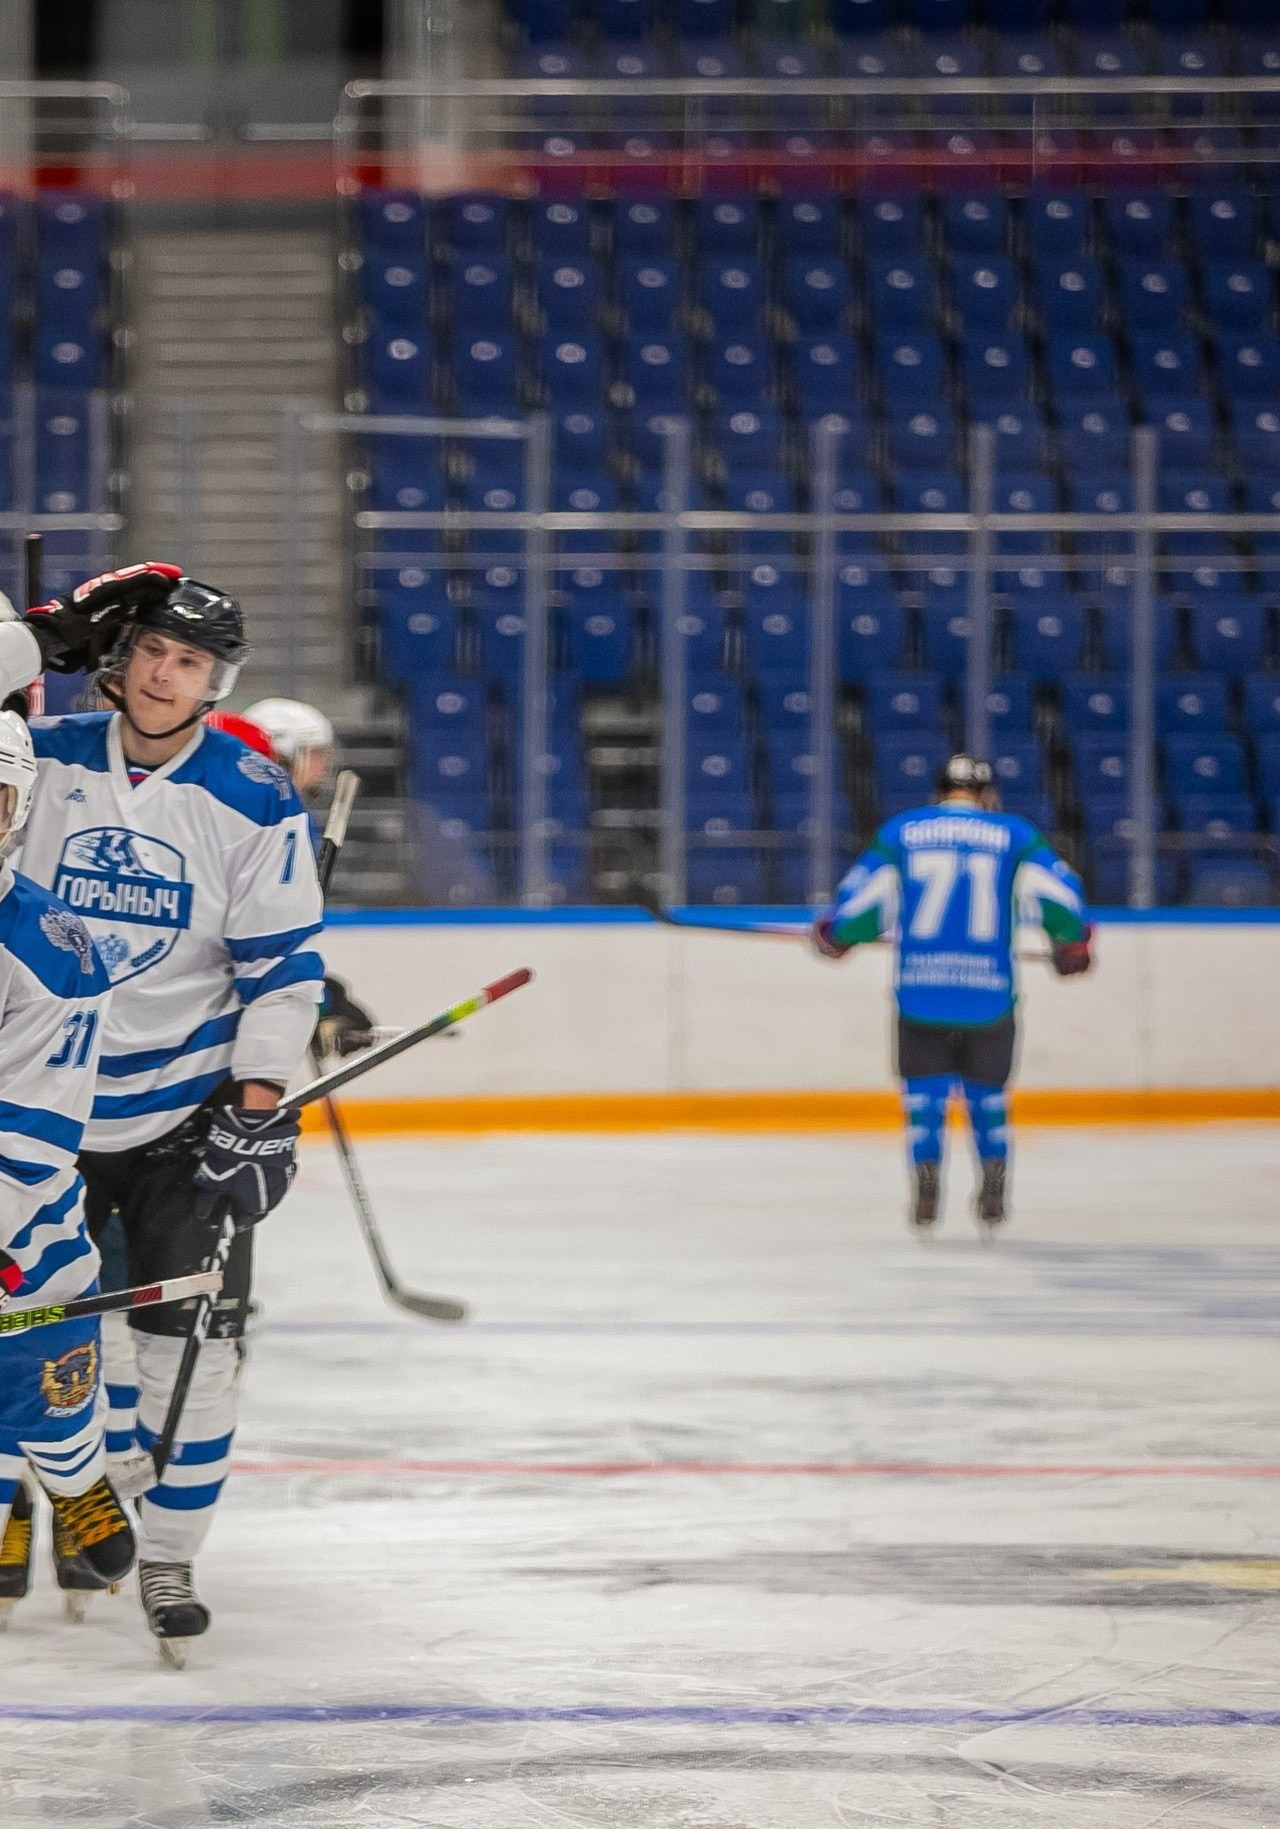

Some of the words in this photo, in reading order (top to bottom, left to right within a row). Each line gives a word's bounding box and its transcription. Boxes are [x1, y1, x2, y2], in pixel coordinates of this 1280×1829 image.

[57, 875, 179, 920] ГОРЫНЫЧ
[908, 850, 1001, 942] 71
[44, 1009, 98, 1069] 31
